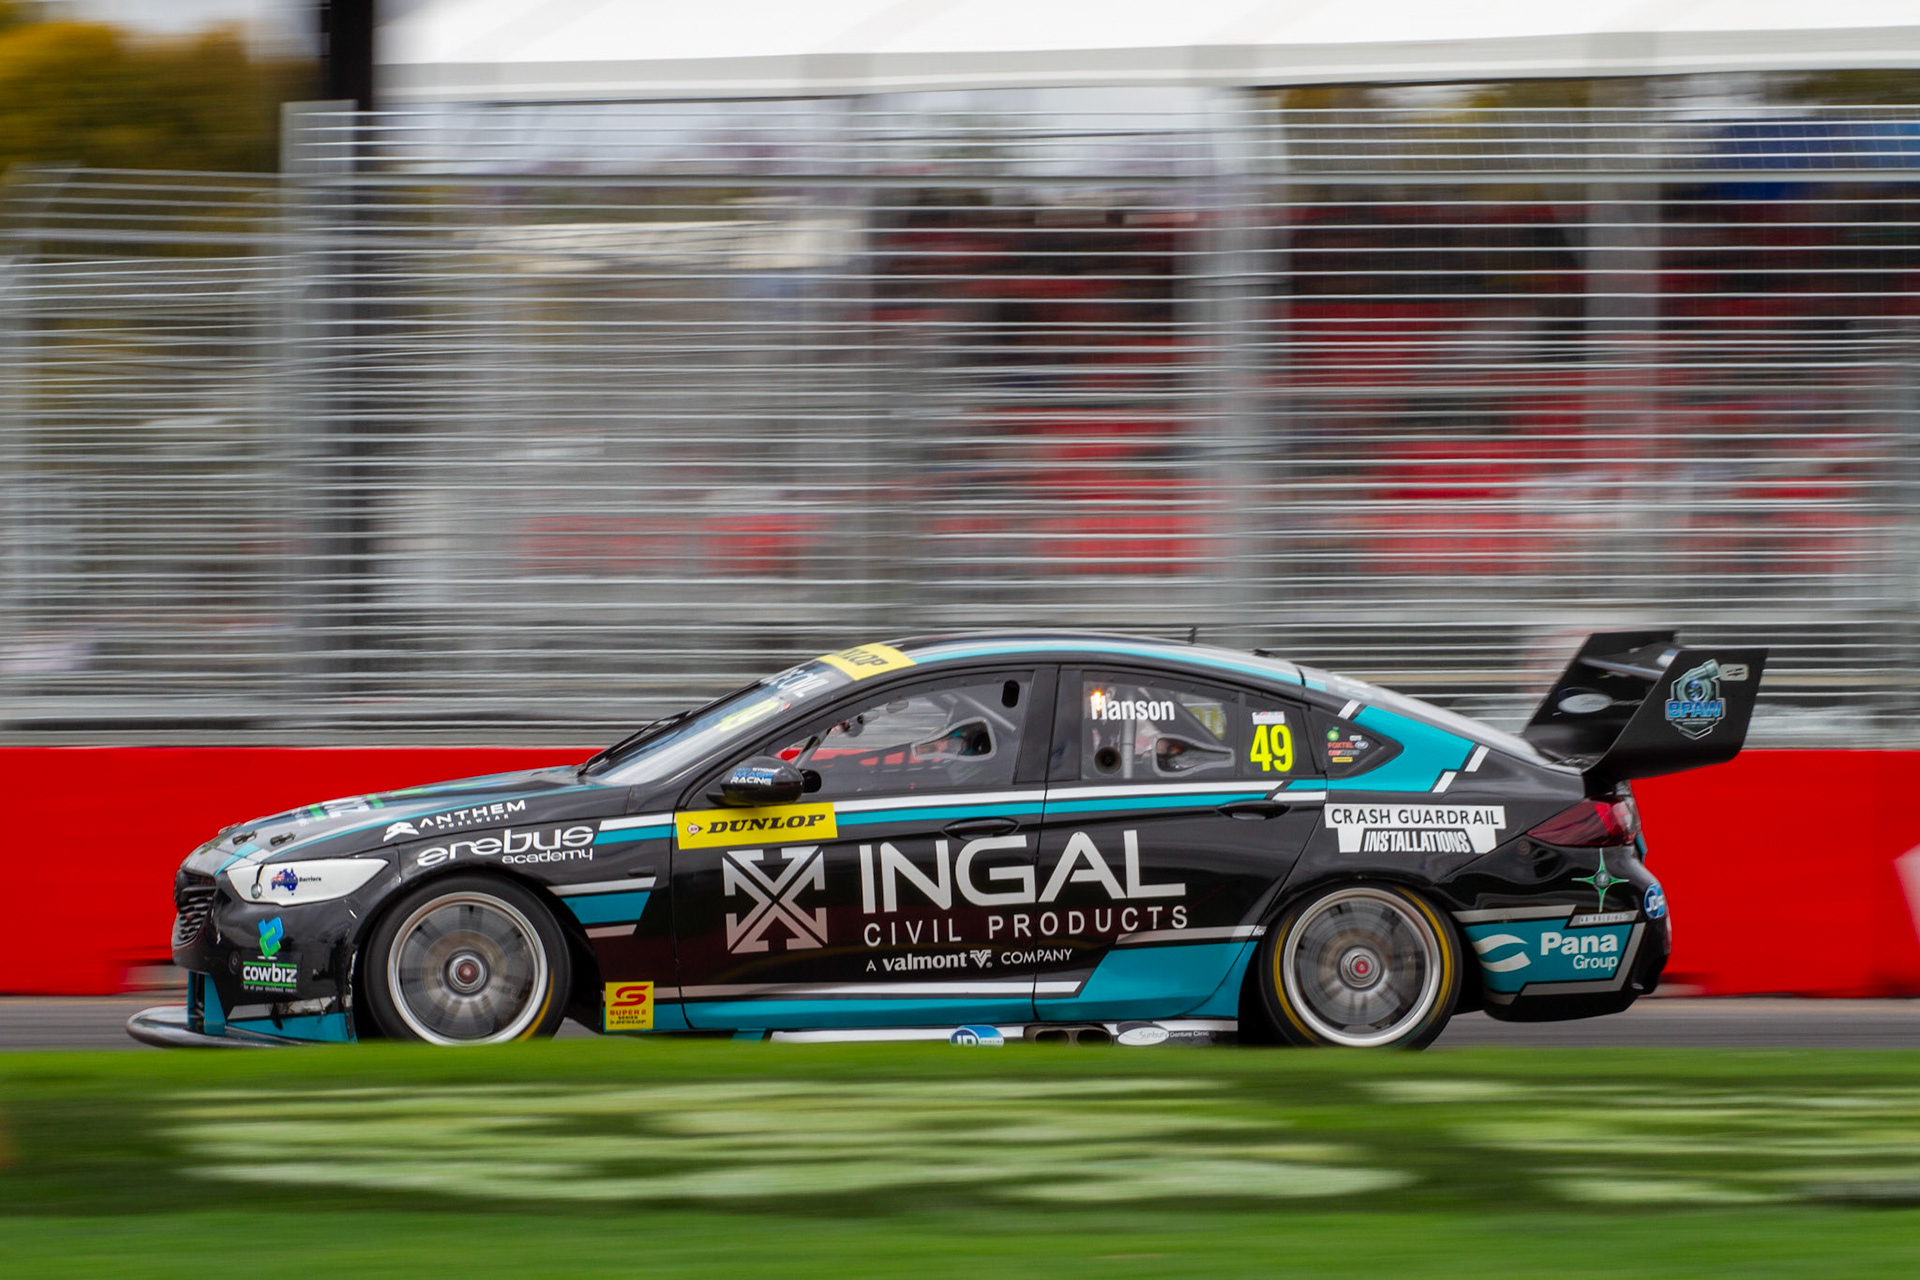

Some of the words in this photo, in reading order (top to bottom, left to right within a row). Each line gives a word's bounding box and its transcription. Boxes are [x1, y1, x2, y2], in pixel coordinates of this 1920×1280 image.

[1090, 698, 1176, 721] Hanson
[1668, 700, 1723, 719] BPAW
[1250, 724, 1293, 772] 49
[731, 777, 772, 785] RACING
[419, 799, 526, 829] ANTHEM
[707, 814, 826, 834] DUNLOP
[1331, 808, 1392, 825] CRASH
[1398, 808, 1500, 826] GUARDRAIL
[417, 826, 593, 866] erebus
[1362, 829, 1471, 853] INSTALLATIONS
[501, 848, 594, 865] academy
[859, 829, 1187, 914] INGAL
[863, 918, 963, 948] CIVIL
[988, 905, 1189, 940] PRODUCTS
[1540, 931, 1619, 956] Pana
[882, 951, 968, 972] valmont
[1000, 948, 1073, 965] COMPANY
[1573, 954, 1619, 971] Group
[243, 963, 297, 983] cowbiz
